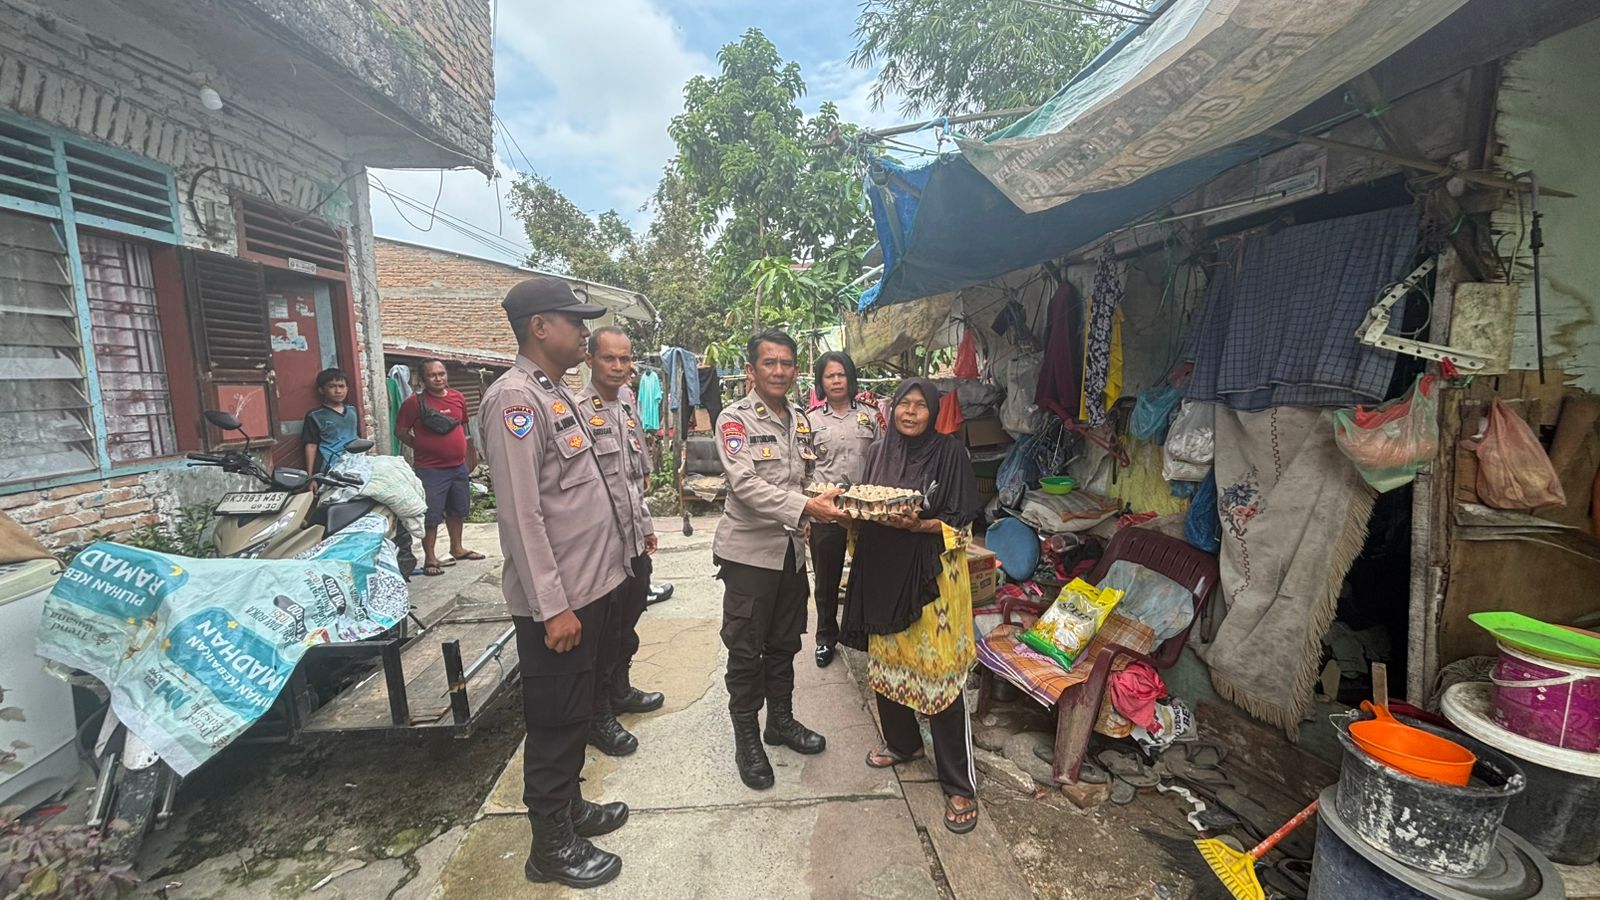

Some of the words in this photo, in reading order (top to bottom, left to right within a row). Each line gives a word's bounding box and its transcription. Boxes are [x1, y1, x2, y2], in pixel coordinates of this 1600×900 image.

[261, 493, 284, 502] WAS
[62, 567, 94, 585] KEB
[80, 549, 166, 596] RAMAD
[93, 578, 147, 607] PILIHAN
[245, 605, 269, 623] BUKA
[50, 622, 89, 641] Trend
[186, 636, 240, 687] KEBAIKAN
[196, 620, 285, 692] MADHAN
